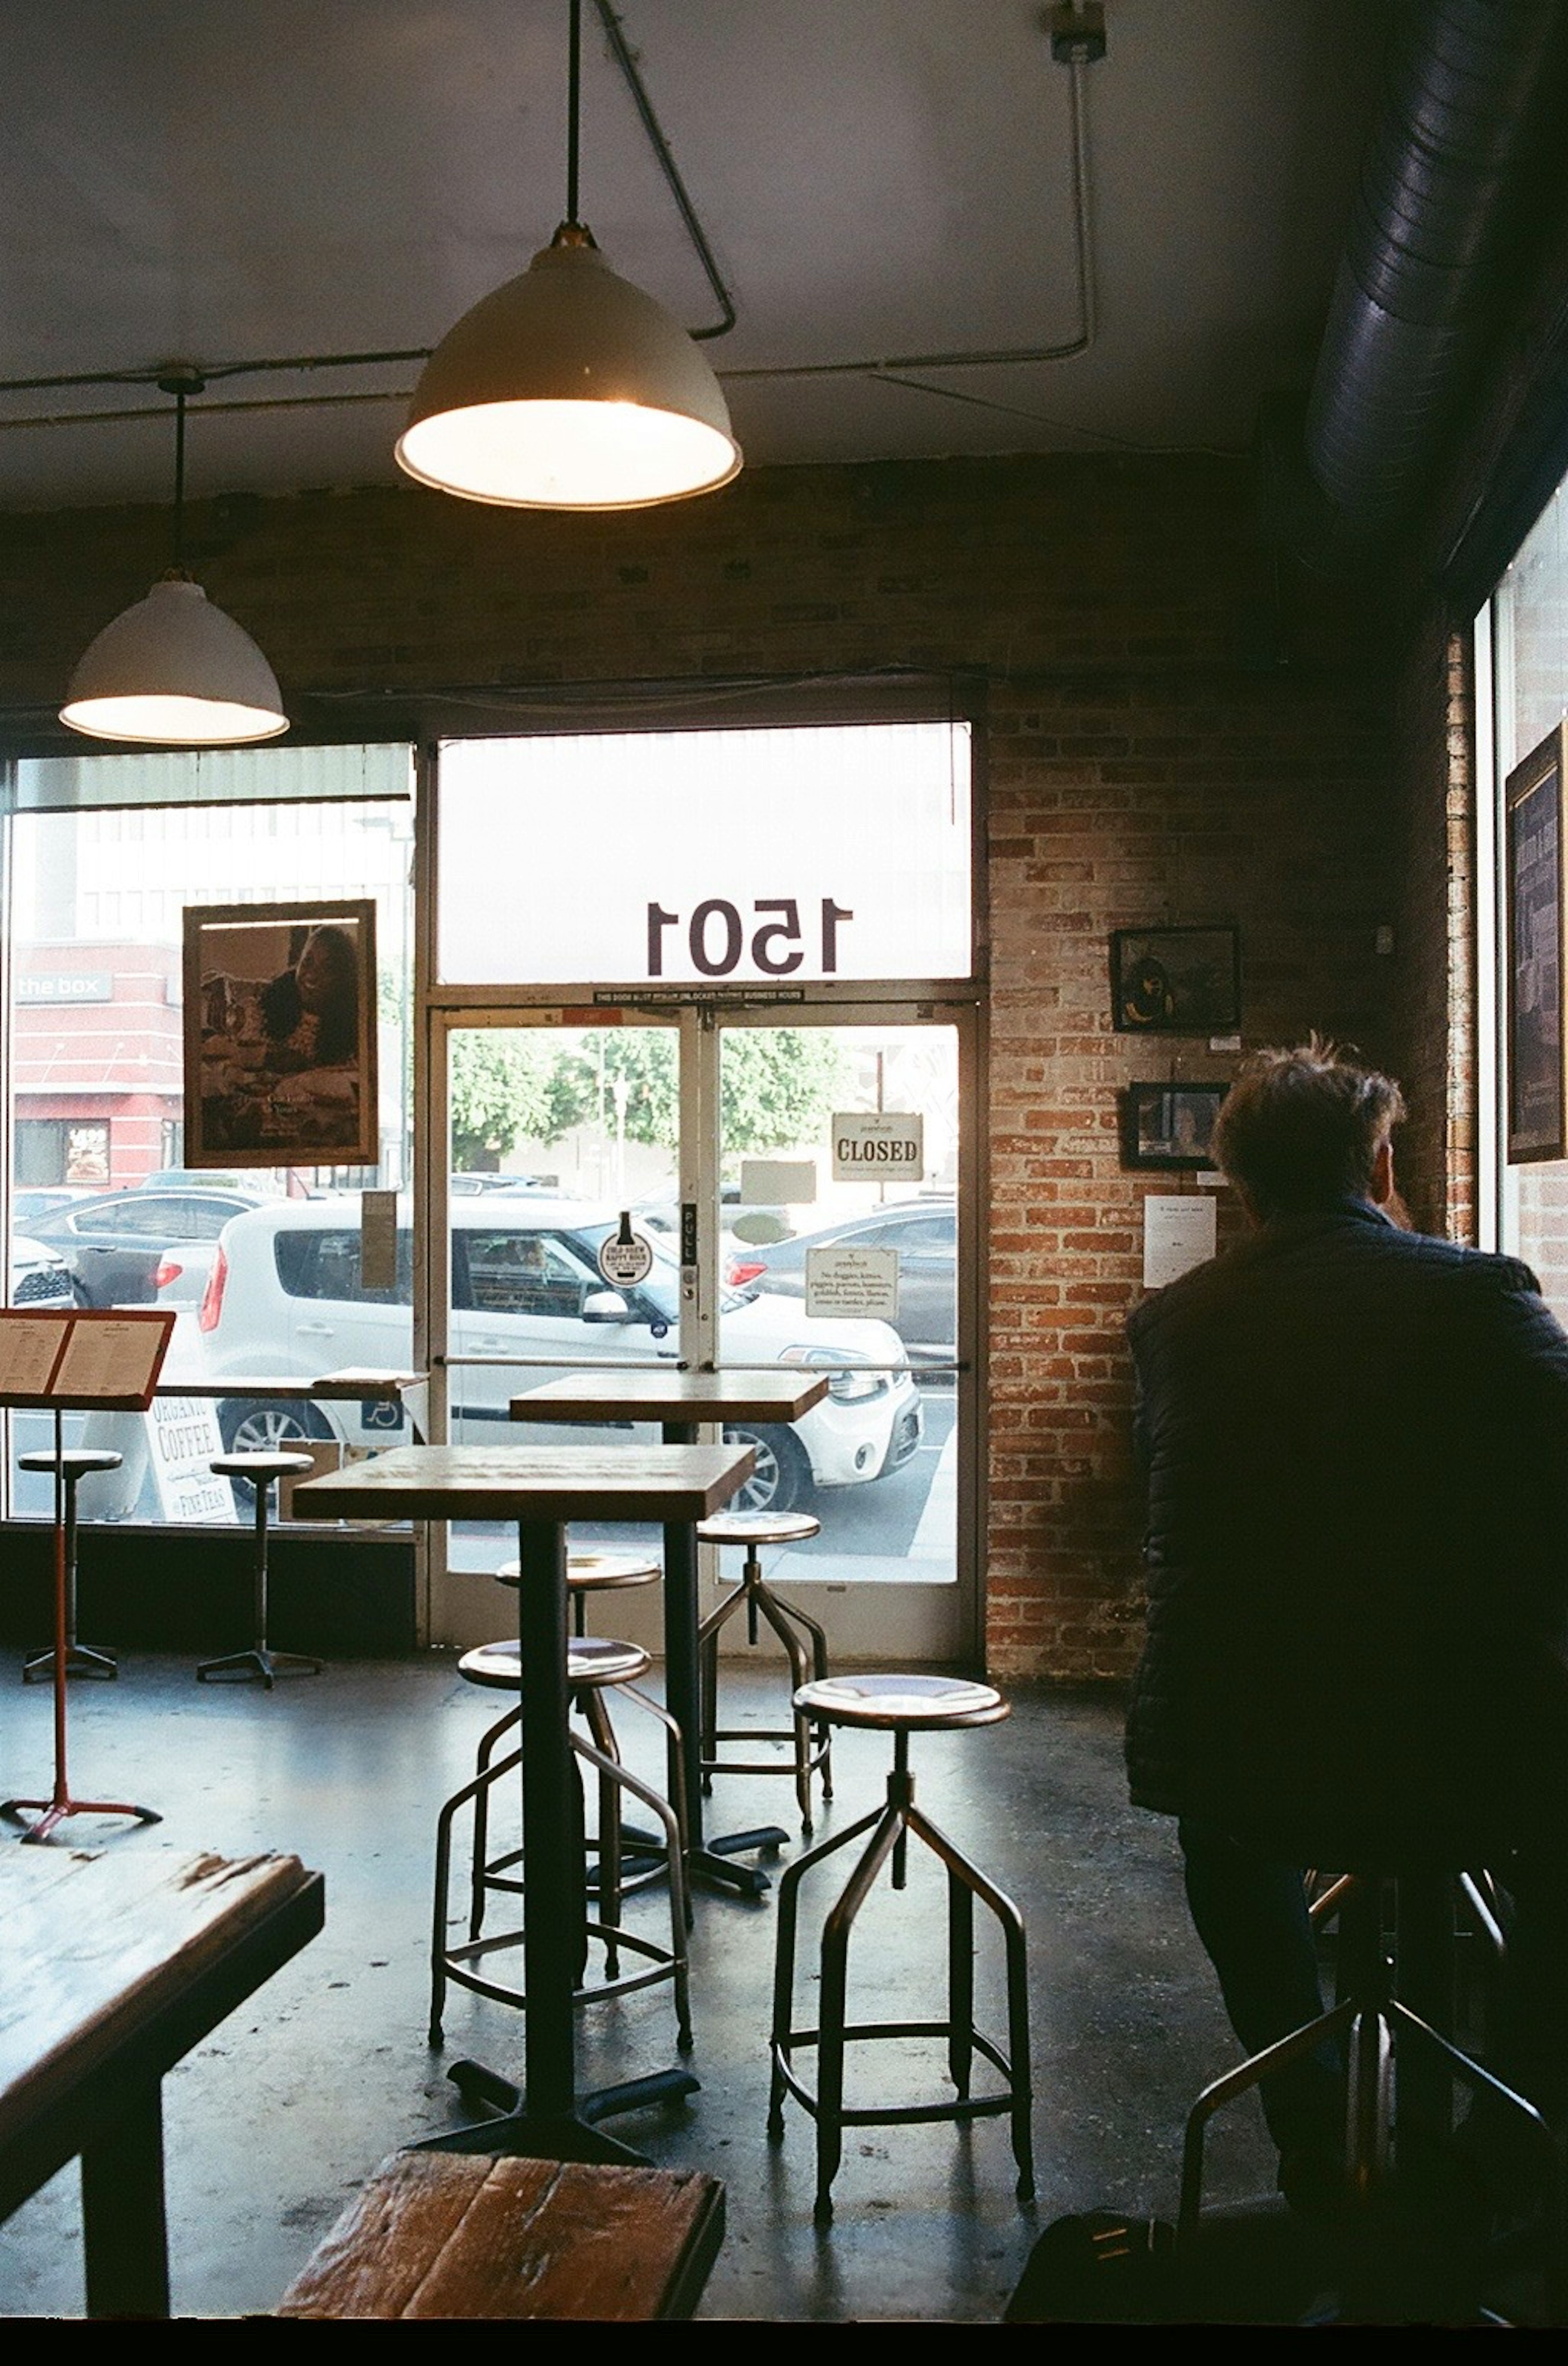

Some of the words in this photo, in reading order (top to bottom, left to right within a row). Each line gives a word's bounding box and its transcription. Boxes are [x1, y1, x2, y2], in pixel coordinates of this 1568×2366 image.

[19, 978, 53, 994] the
[58, 978, 98, 994] box
[837, 1138, 917, 1161] CLOSED
[158, 1424, 214, 1462] COFFEE
